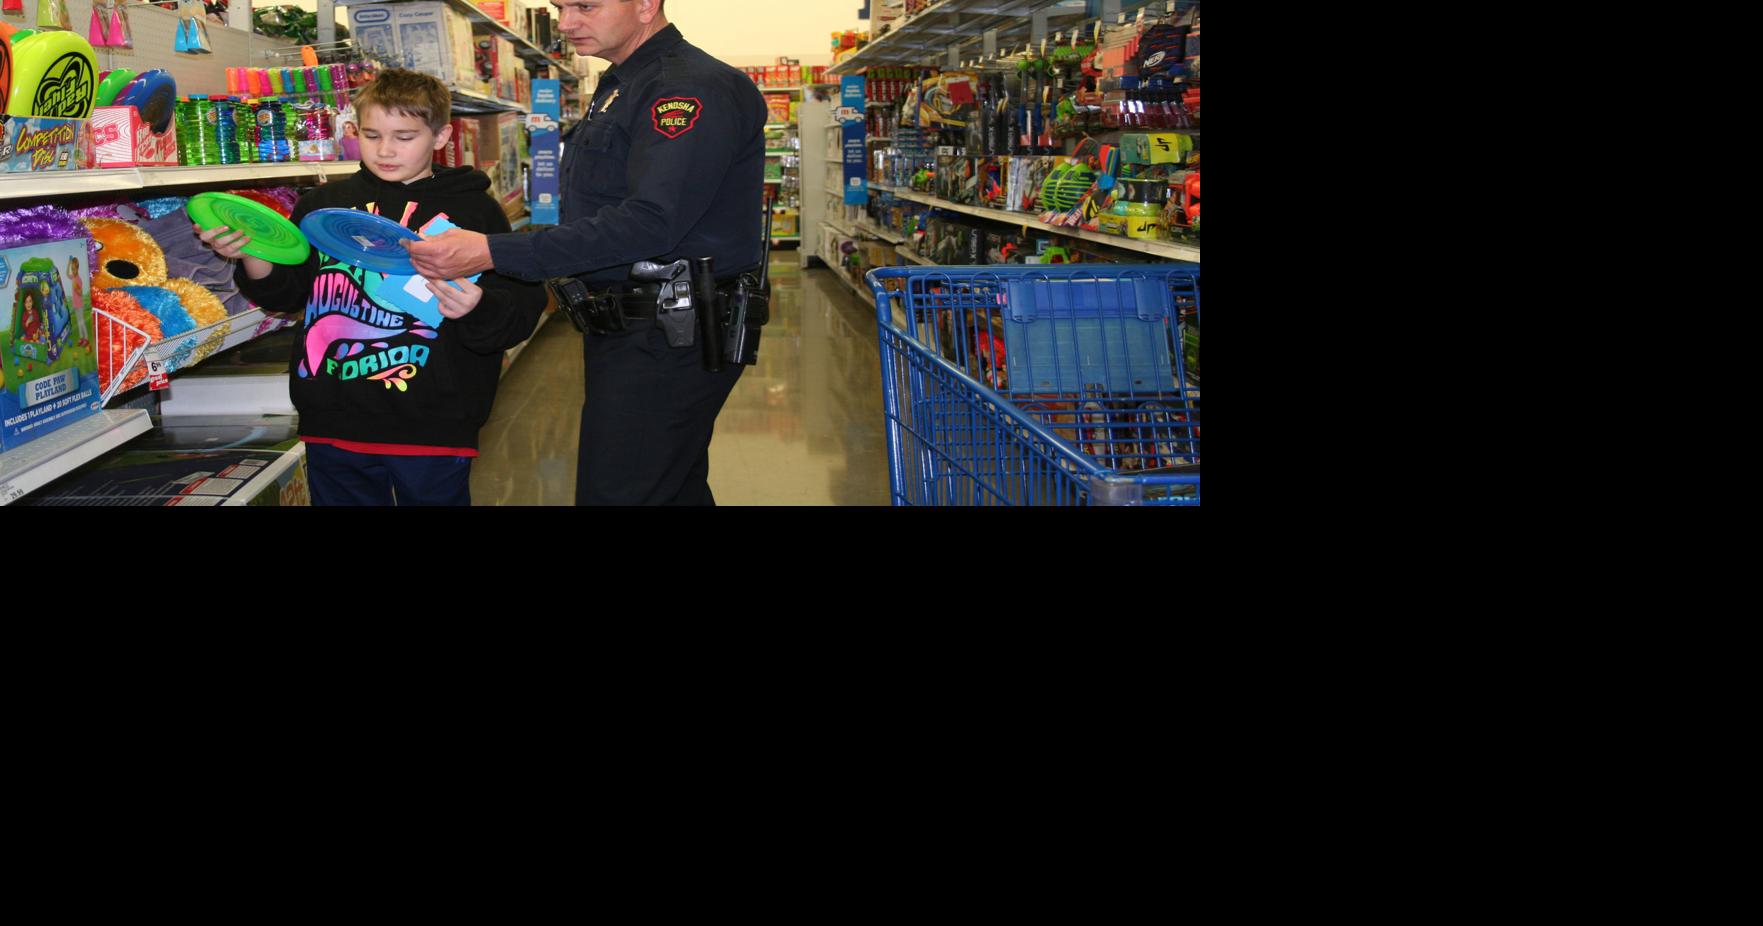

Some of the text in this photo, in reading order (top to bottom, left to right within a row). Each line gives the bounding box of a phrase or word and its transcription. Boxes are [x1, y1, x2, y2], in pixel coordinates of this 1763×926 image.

[657, 101, 695, 113] KENOSHA
[661, 117, 687, 126] POLICE
[304, 272, 404, 329] AUGUSTINE
[326, 344, 430, 381] FORIDA
[35, 374, 66, 391] CODE PAW
[35, 384, 67, 400] PLAYLAND
[4, 413, 28, 427] INCLUDES
[30, 404, 53, 418] PLAYLAND
